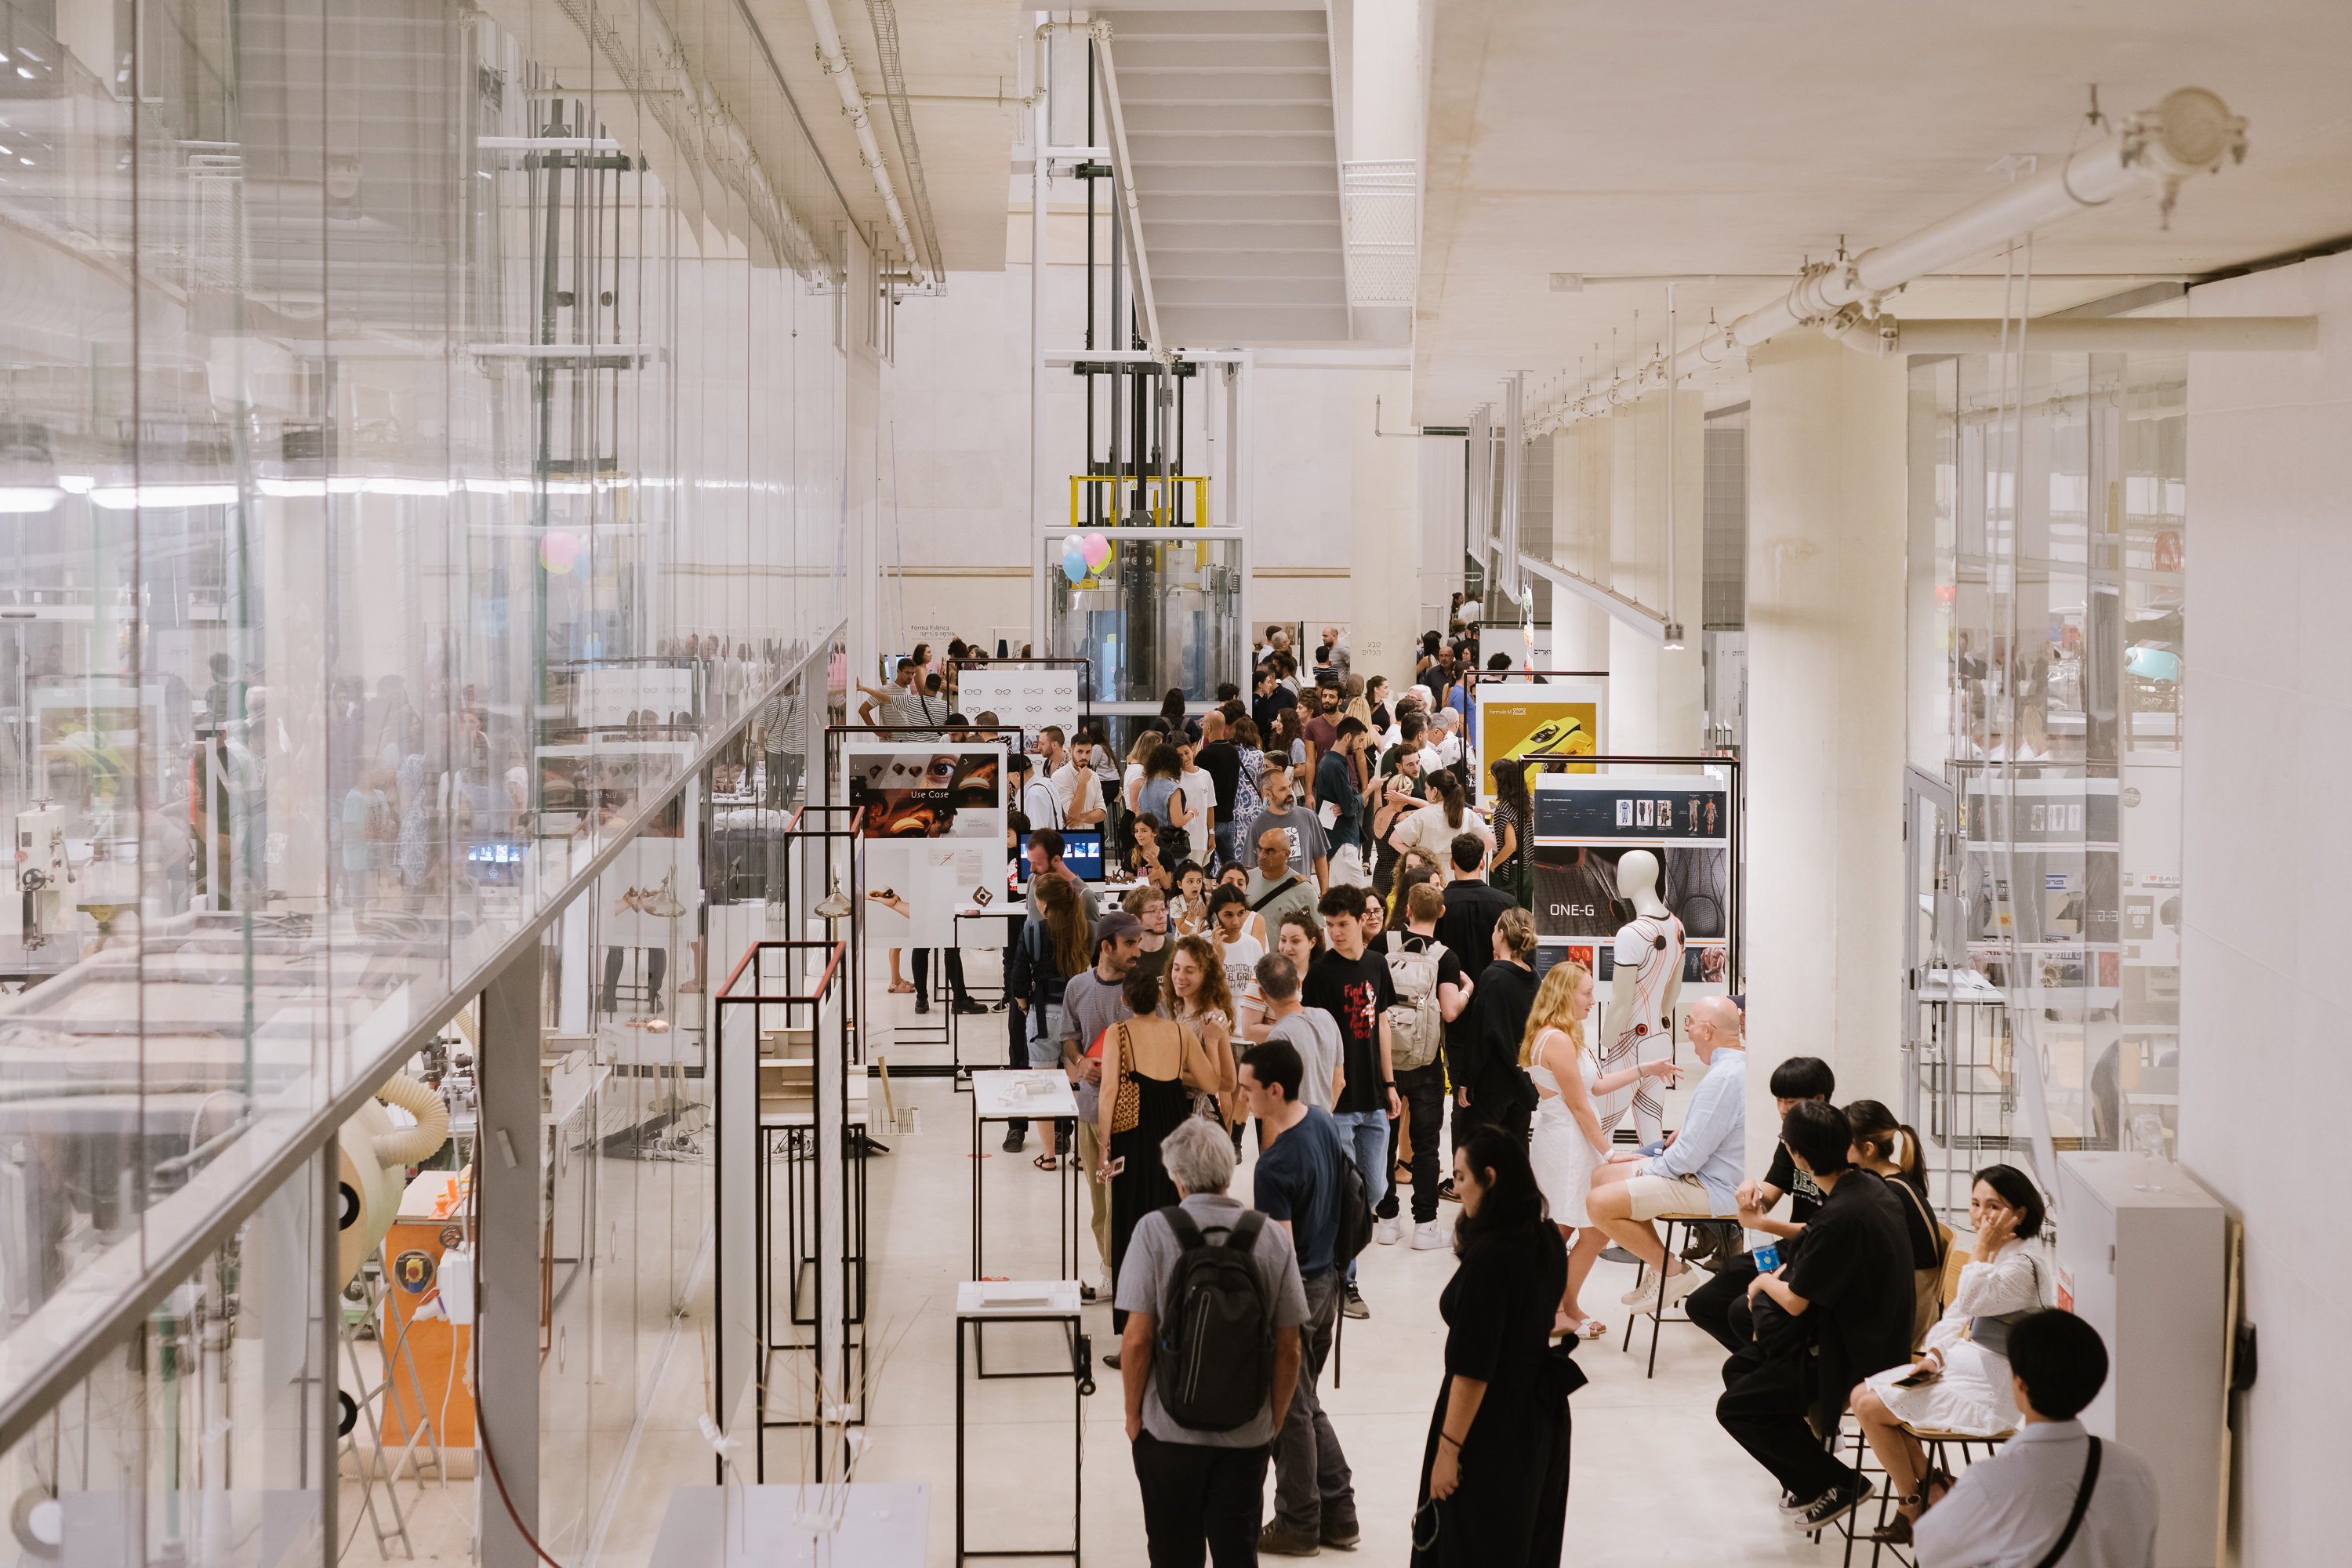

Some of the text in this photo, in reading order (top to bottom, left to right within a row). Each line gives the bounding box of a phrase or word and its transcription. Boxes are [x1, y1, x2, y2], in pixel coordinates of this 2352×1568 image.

[911, 790, 949, 799] Use Case
[1550, 904, 1595, 916] ONE-G
[1344, 982, 1364, 998] Find
